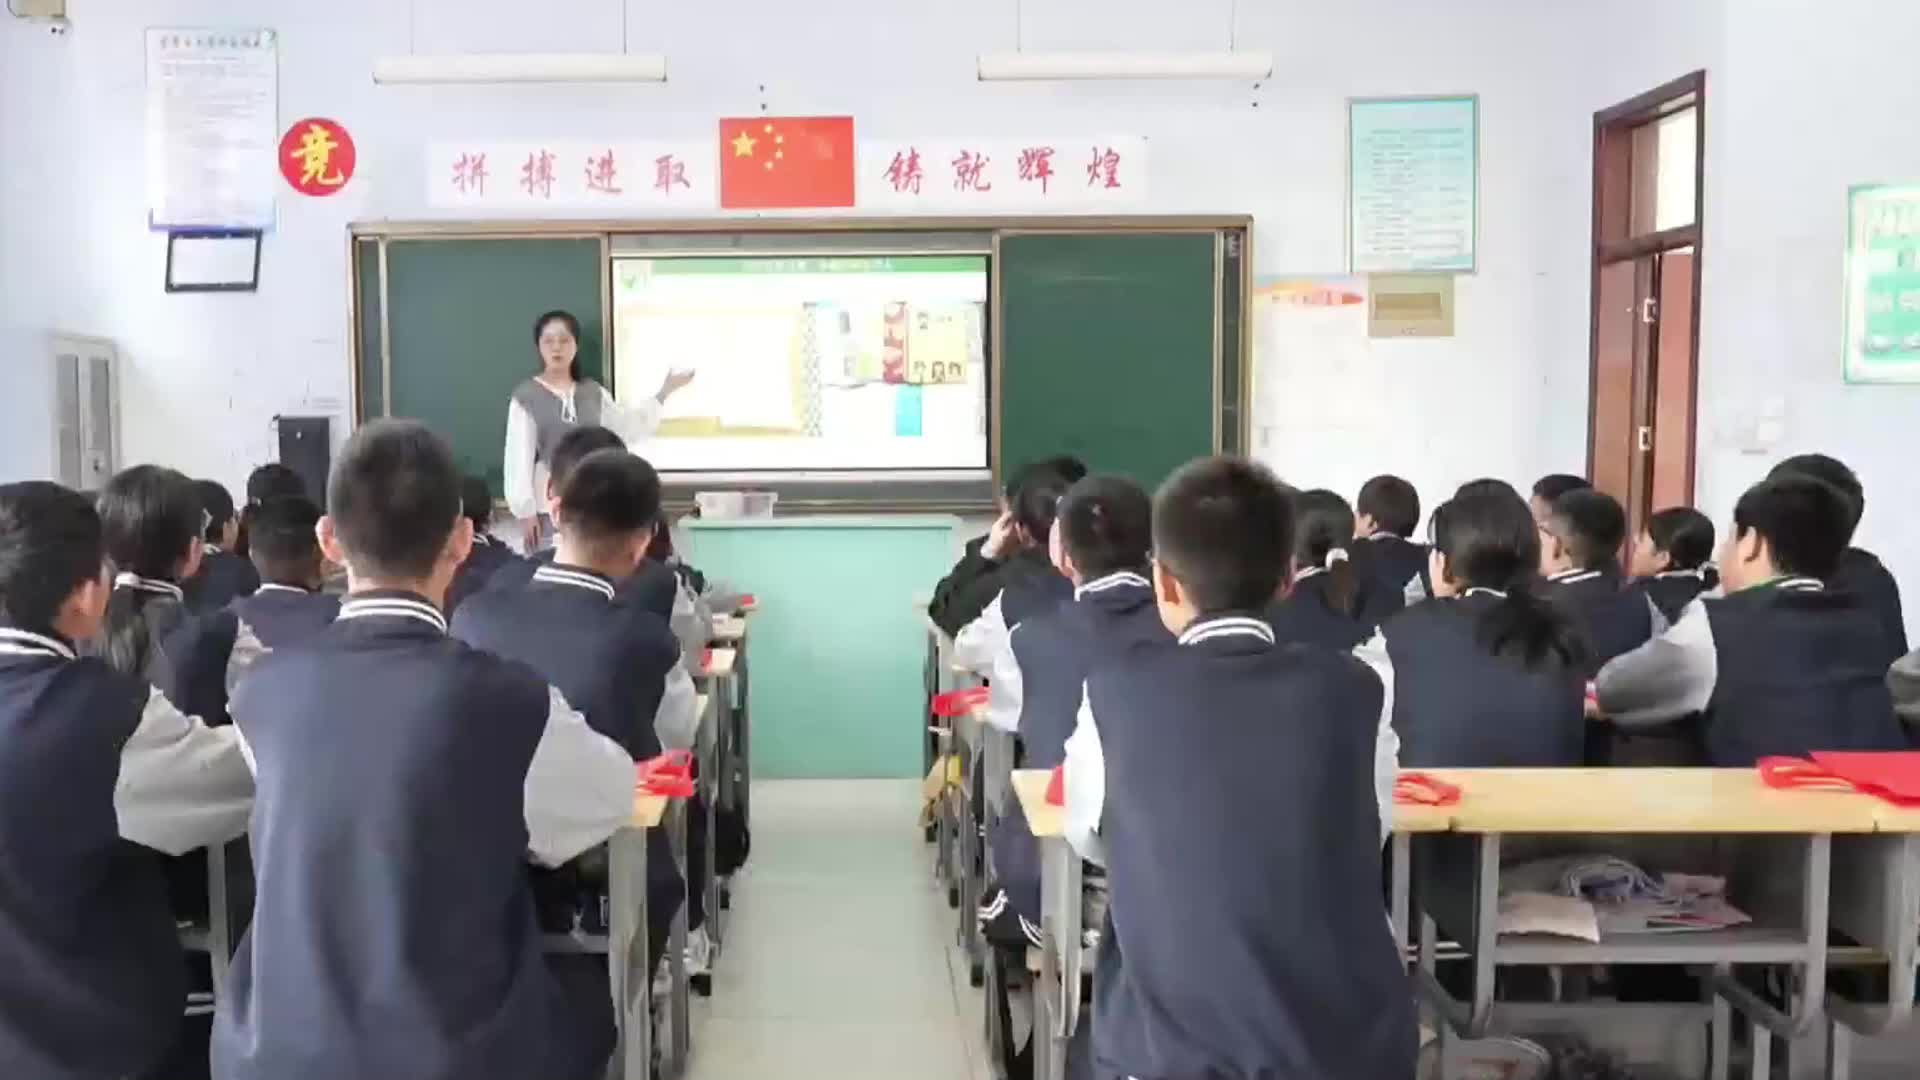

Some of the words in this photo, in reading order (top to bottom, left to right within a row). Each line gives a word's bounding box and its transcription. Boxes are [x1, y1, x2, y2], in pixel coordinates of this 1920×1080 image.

[291, 123, 344, 186] 竞
[452, 149, 691, 198] 拼搏进取
[883, 146, 1122, 195] 铸就辉煌
